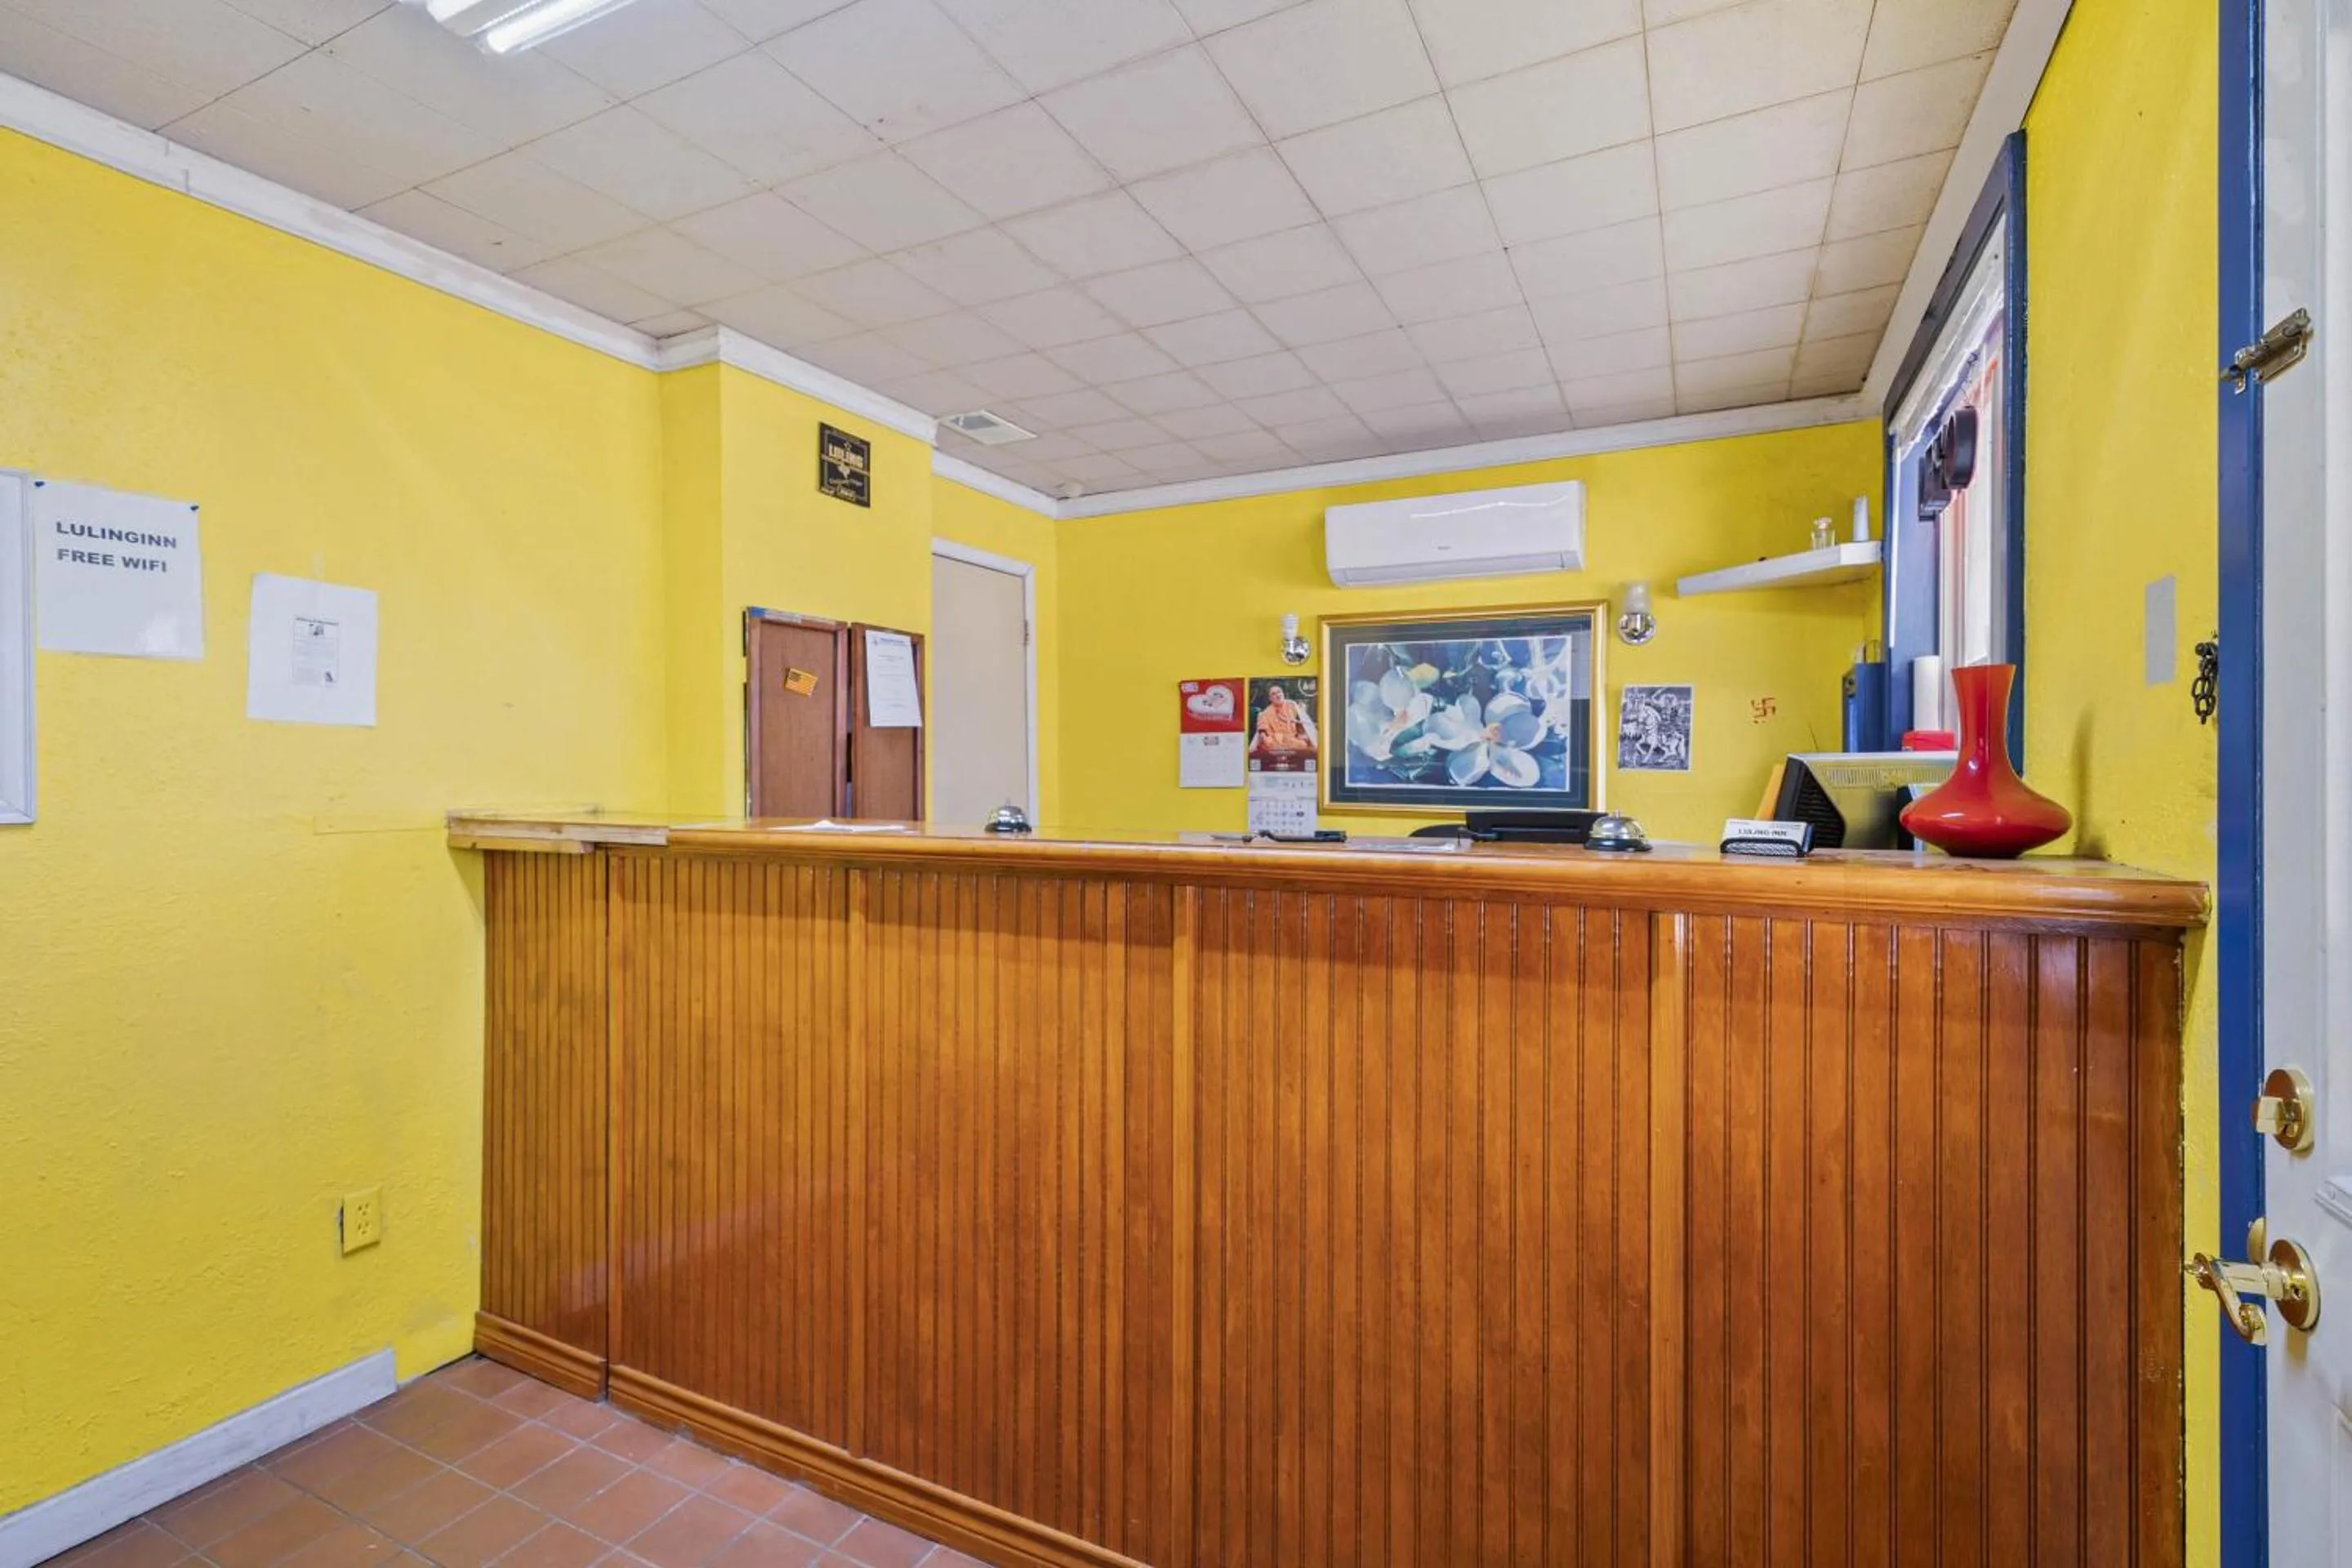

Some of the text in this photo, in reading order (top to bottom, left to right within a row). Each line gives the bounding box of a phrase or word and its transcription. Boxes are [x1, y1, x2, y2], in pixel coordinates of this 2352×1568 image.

[56, 521, 177, 549] LULINGINN
[57, 548, 167, 572] FREE WIFI
